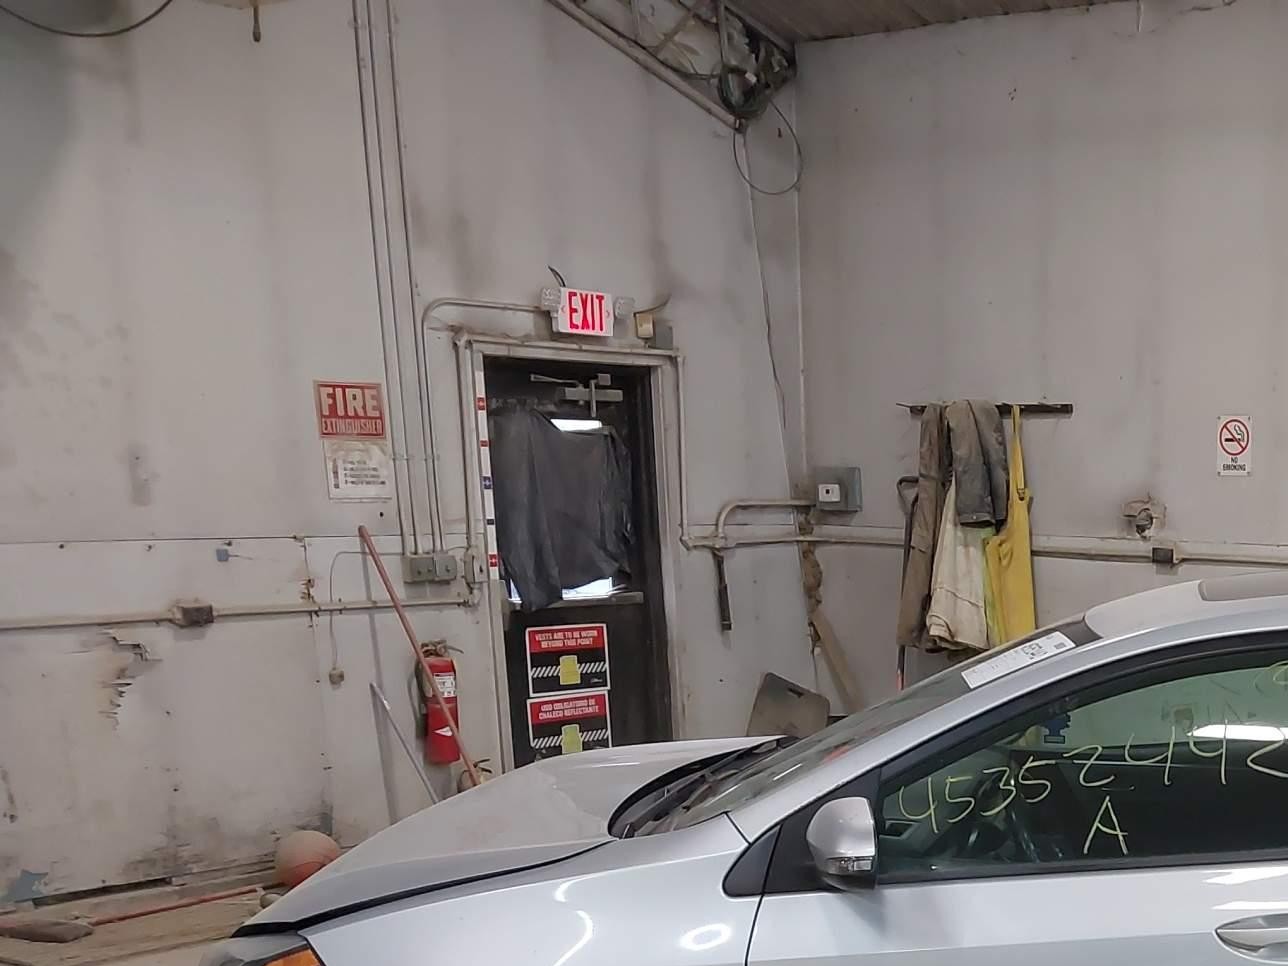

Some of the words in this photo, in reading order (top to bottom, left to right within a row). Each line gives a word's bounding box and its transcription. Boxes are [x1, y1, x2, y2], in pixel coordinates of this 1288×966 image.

[568, 291, 604, 331] EXIT
[320, 387, 380, 416] FIRE
[322, 418, 382, 434] EXTINGUISHER
[553, 631, 564, 639] ARE
[538, 710, 563, 720] CHALECO
[564, 706, 599, 716] REFLECTANTE
[1084, 795, 1129, 854] A
